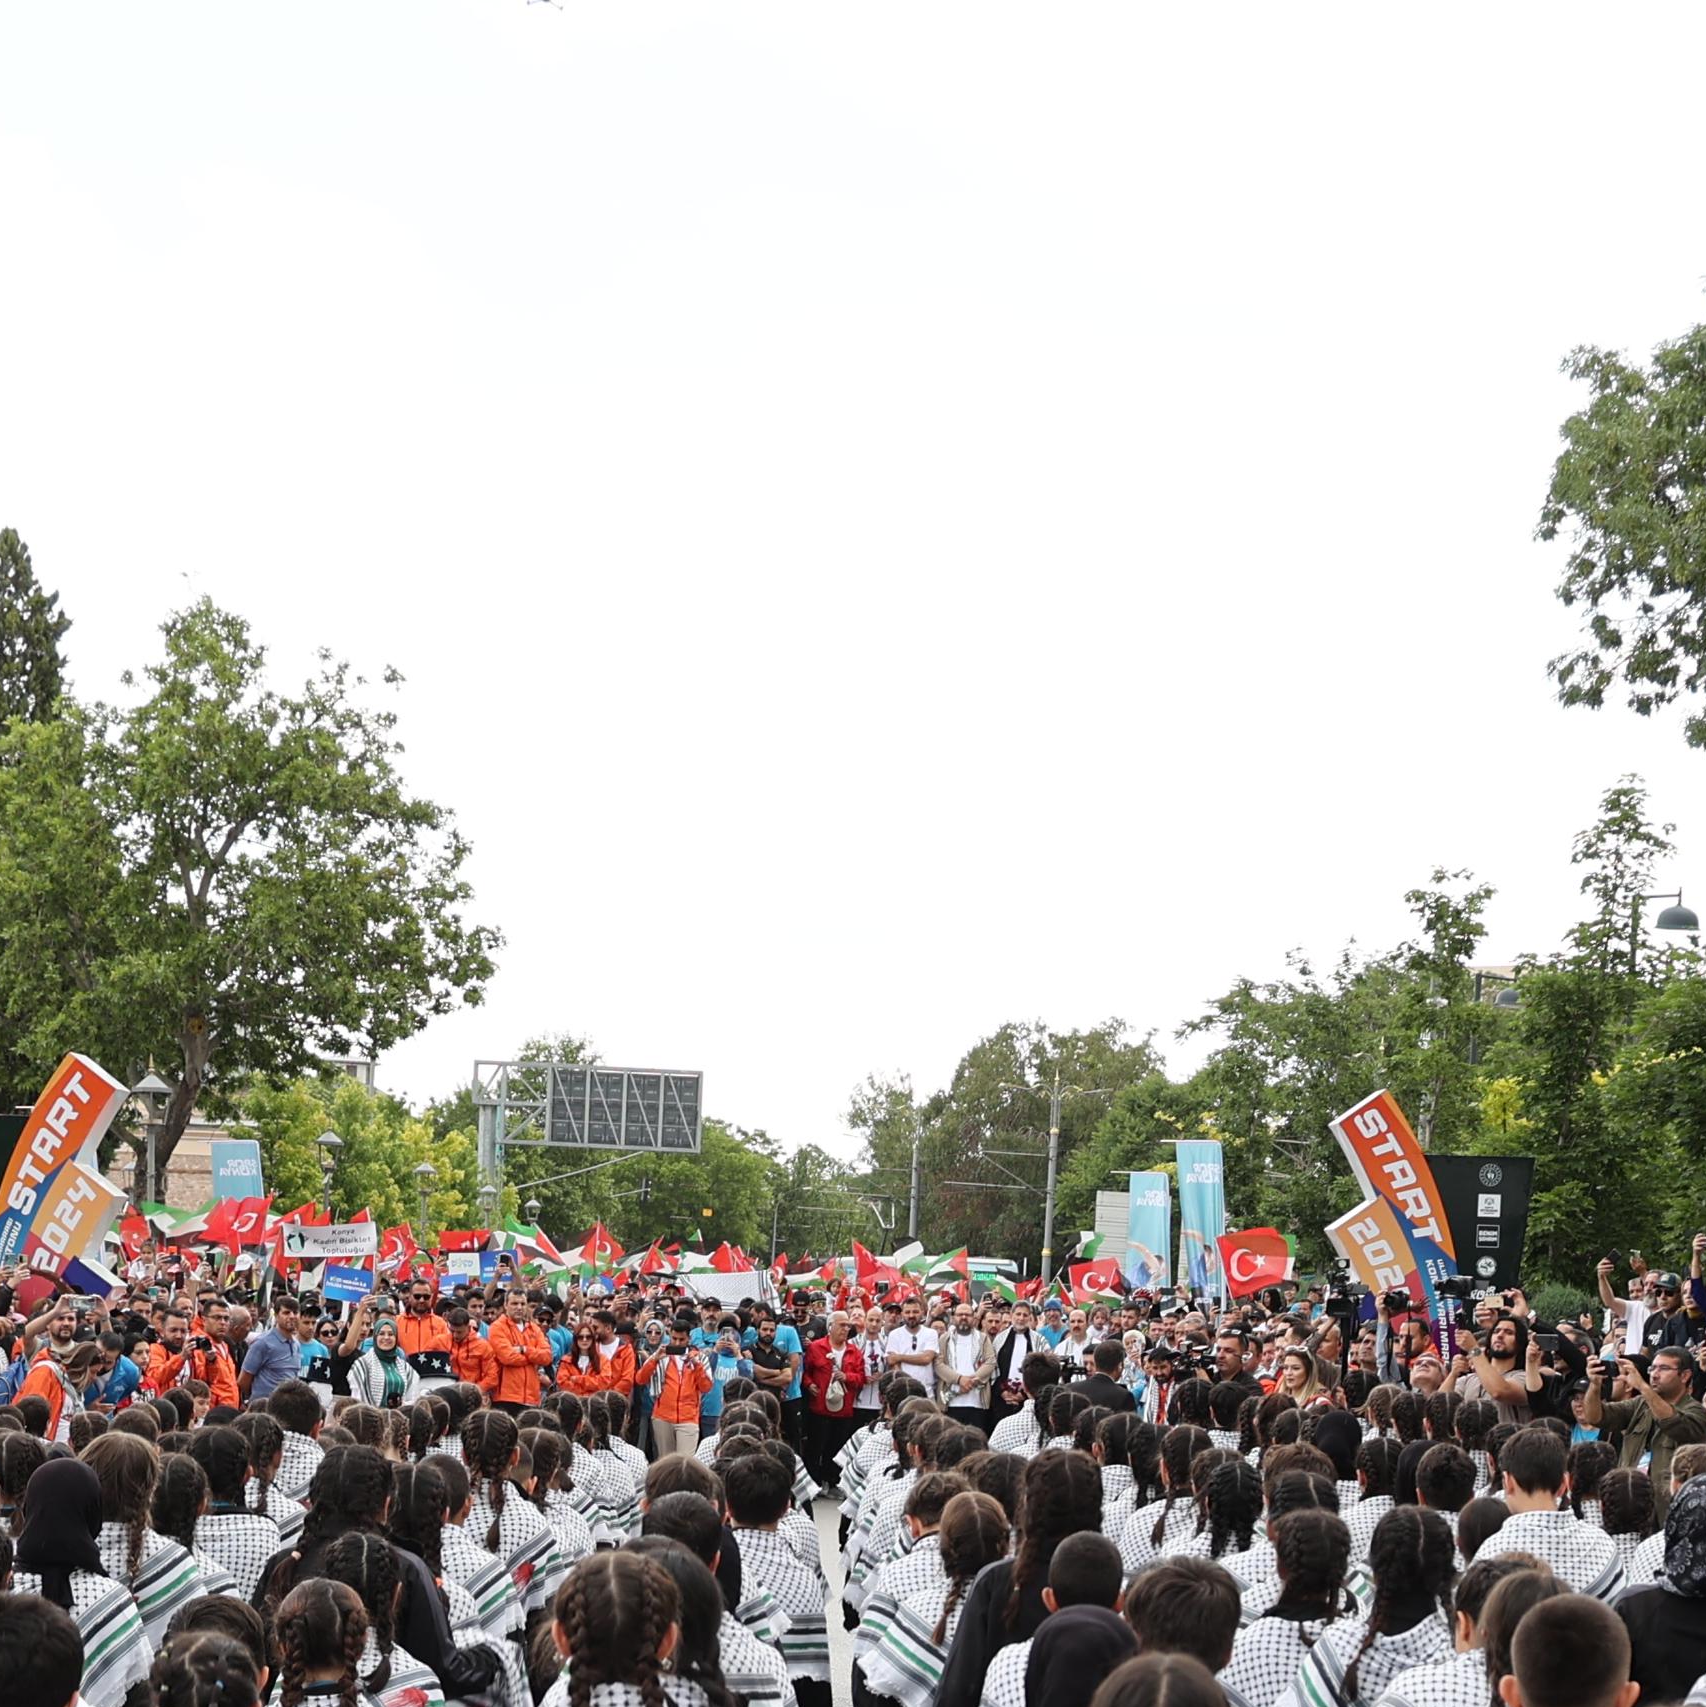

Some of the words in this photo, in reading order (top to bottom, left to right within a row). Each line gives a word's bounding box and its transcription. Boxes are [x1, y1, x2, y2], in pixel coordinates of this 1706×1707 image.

[7, 1071, 91, 1216] START
[1353, 1107, 1443, 1243] START
[31, 1176, 98, 1274] 2024
[331, 1228, 355, 1237] Konya
[1436, 1301, 1447, 1329] YARI
